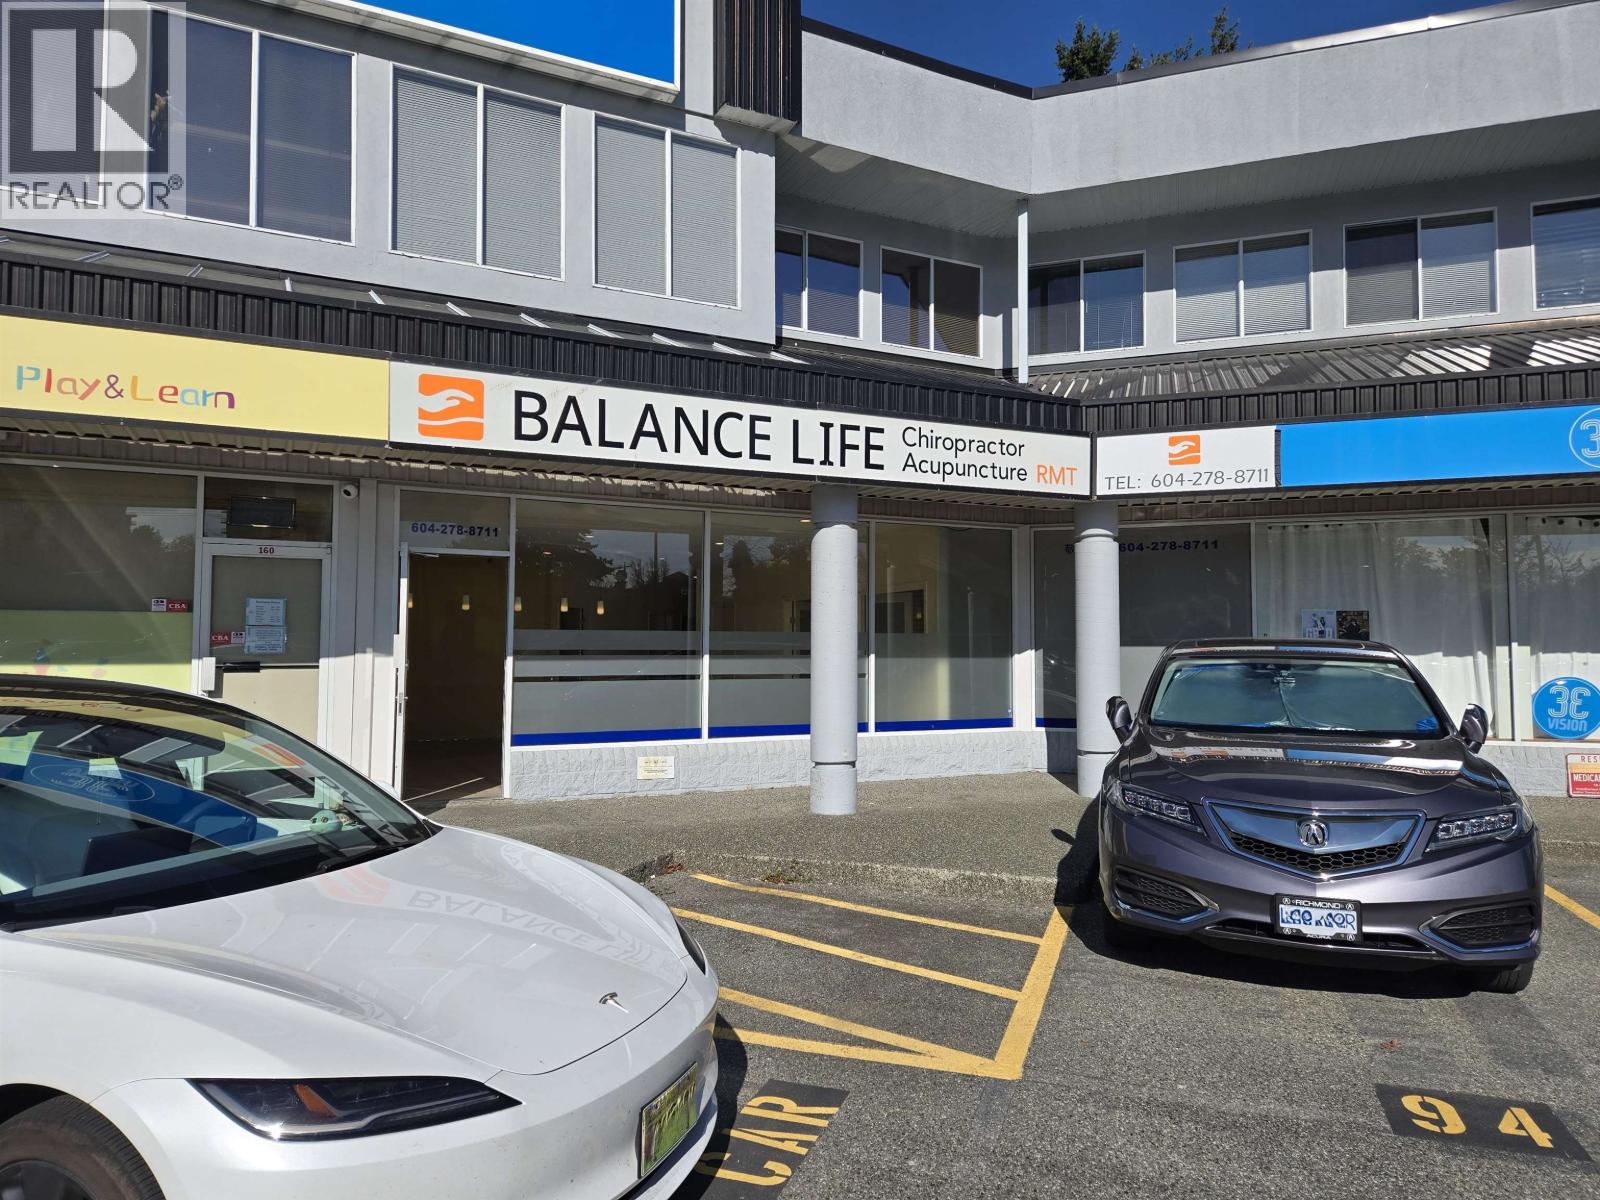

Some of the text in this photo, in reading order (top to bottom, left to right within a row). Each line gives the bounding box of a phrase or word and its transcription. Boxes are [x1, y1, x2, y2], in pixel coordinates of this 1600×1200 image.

[513, 390, 885, 470] BALANCE LIFE
[902, 426, 1025, 457] Chiropractor
[902, 452, 1077, 487] Acupuncture RMT
[1104, 467, 1269, 496] TEL: 604-278-8711
[411, 522, 499, 537] 604-278-8711
[258, 546, 275, 555] 160
[1119, 539, 1219, 552] 604-278-8711
[1580, 755, 1600, 763] RES
[1573, 773, 1600, 782] MEDICA
[1295, 899, 1341, 909] RICHMOND
[695, 1095, 840, 1186] CAR
